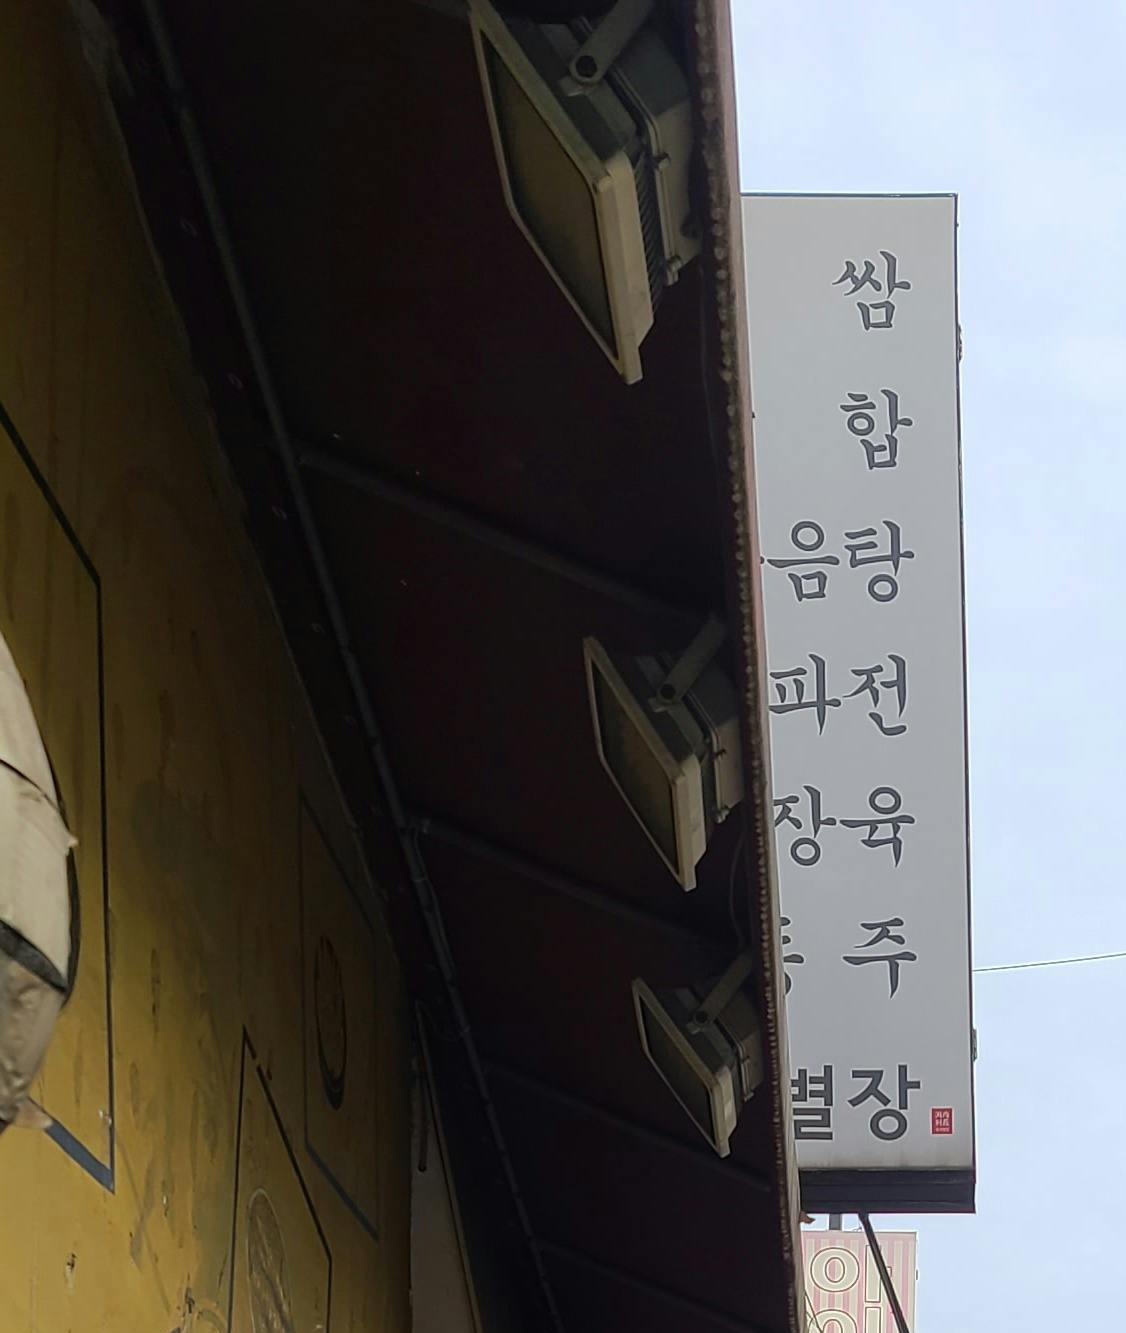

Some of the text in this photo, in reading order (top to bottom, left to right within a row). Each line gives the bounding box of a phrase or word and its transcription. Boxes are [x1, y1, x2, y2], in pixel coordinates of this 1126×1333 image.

[832, 249, 911, 332] 쌈
[839, 388, 914, 470] 합
[768, 653, 908, 737] 파전
[772, 785, 916, 868] 장육
[791, 1063, 922, 1142] 별장
